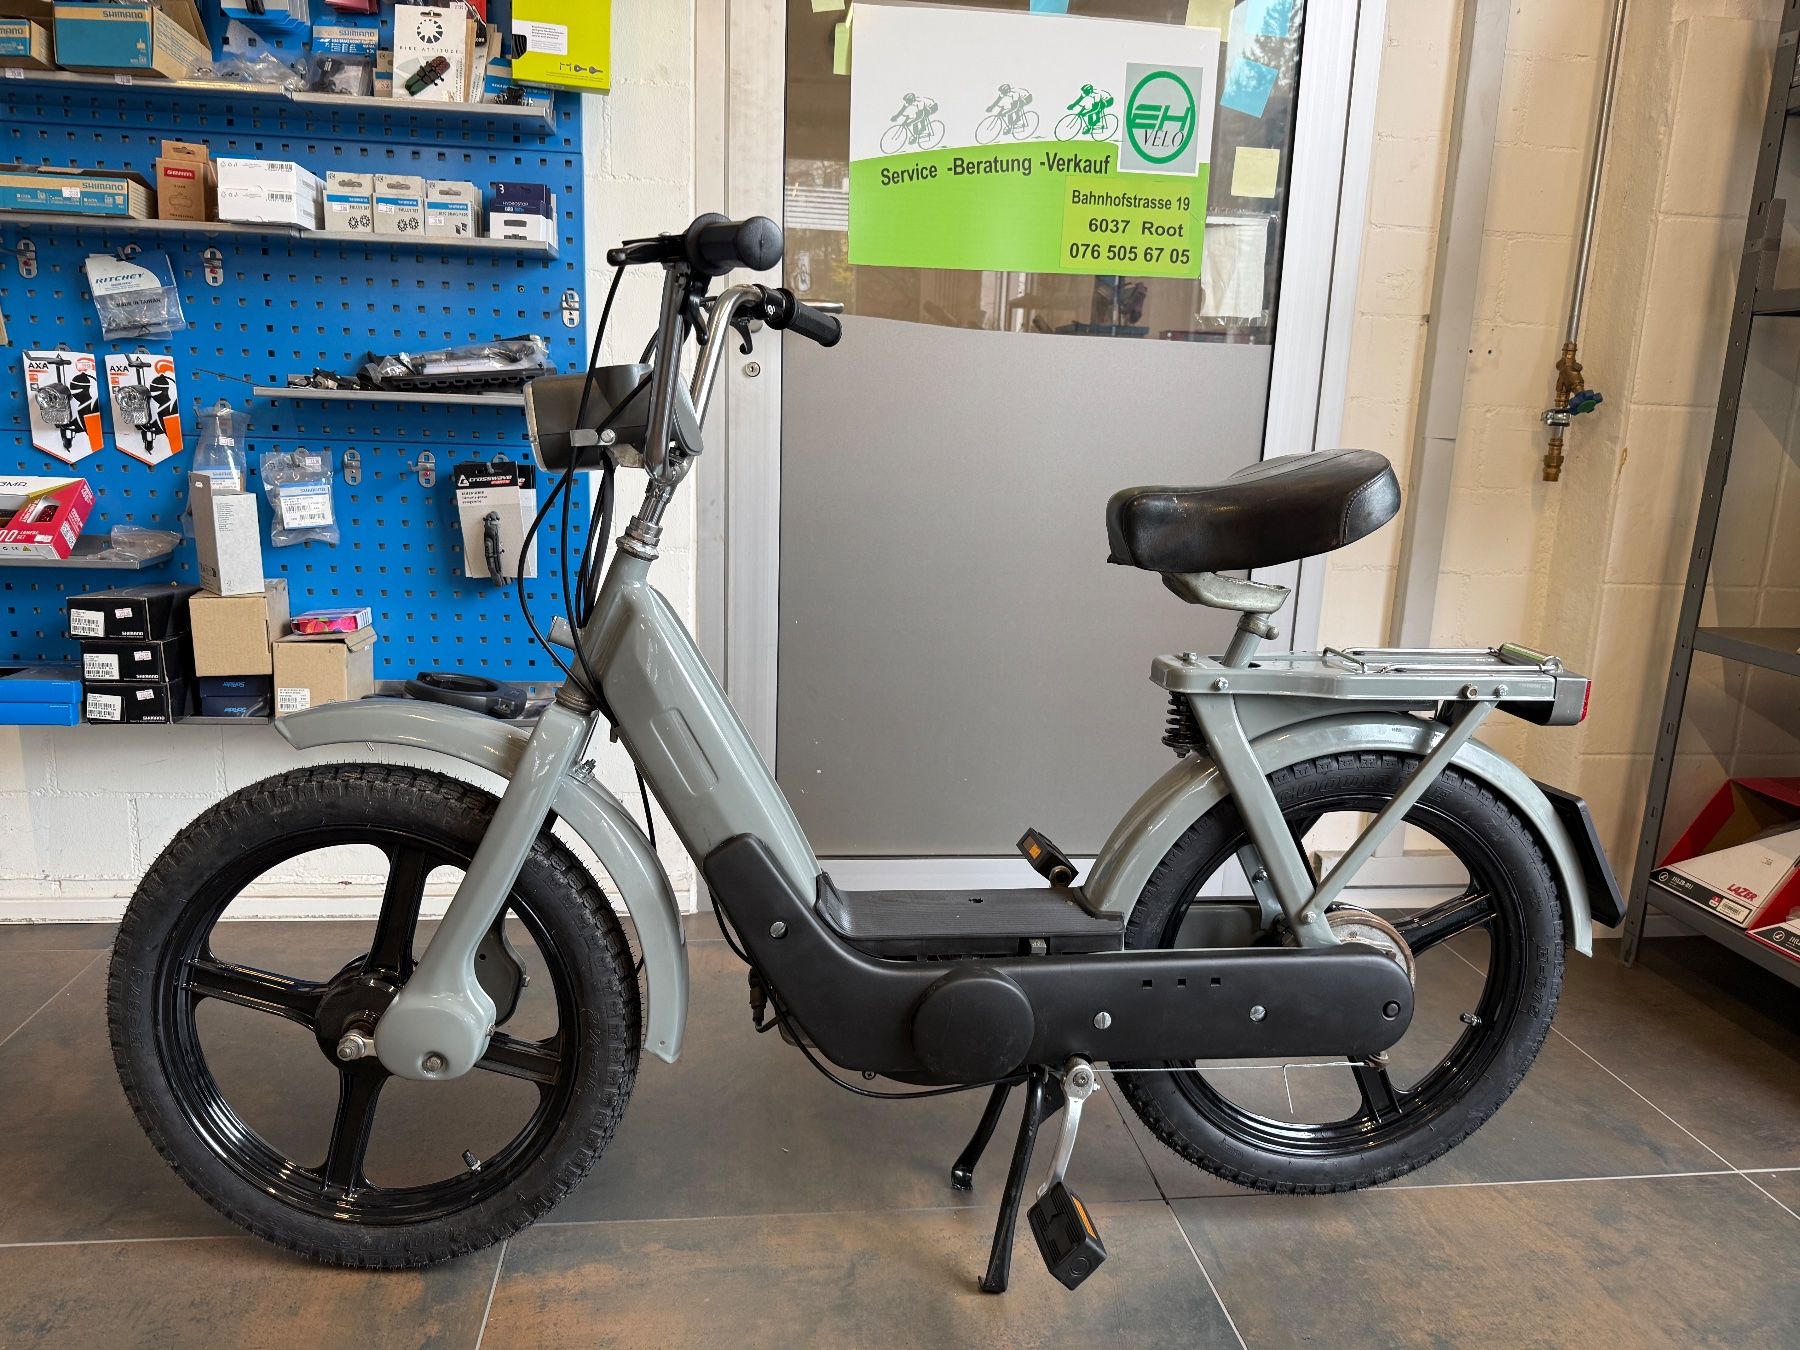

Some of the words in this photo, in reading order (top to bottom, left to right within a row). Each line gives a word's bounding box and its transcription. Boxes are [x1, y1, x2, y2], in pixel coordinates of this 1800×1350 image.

[102, 10, 144, 19] SHIMANO
[1142, 129, 1185, 148] VELO
[166, 169, 193, 177] SRAM
[881, 163, 938, 186] Service
[947, 155, 1033, 177] -Beratung
[1040, 152, 1110, 175] -Verkauf
[81, 182, 124, 191] SHIMANO
[1072, 190, 1172, 211] Bahnhofstrasse
[1176, 196, 1190, 211] 19
[1088, 217, 1131, 235] 6037
[1141, 220, 1184, 237] Root
[1069, 242, 1101, 260] 076
[1106, 244, 1138, 262] 505
[1143, 246, 1164, 264] 67
[1169, 247, 1190, 265] 05
[96, 273, 144, 284] RITCHEY
[28, 362, 49, 370] AXA
[109, 365, 130, 373] AXA
[1726, 883, 1758, 902] LAZER
